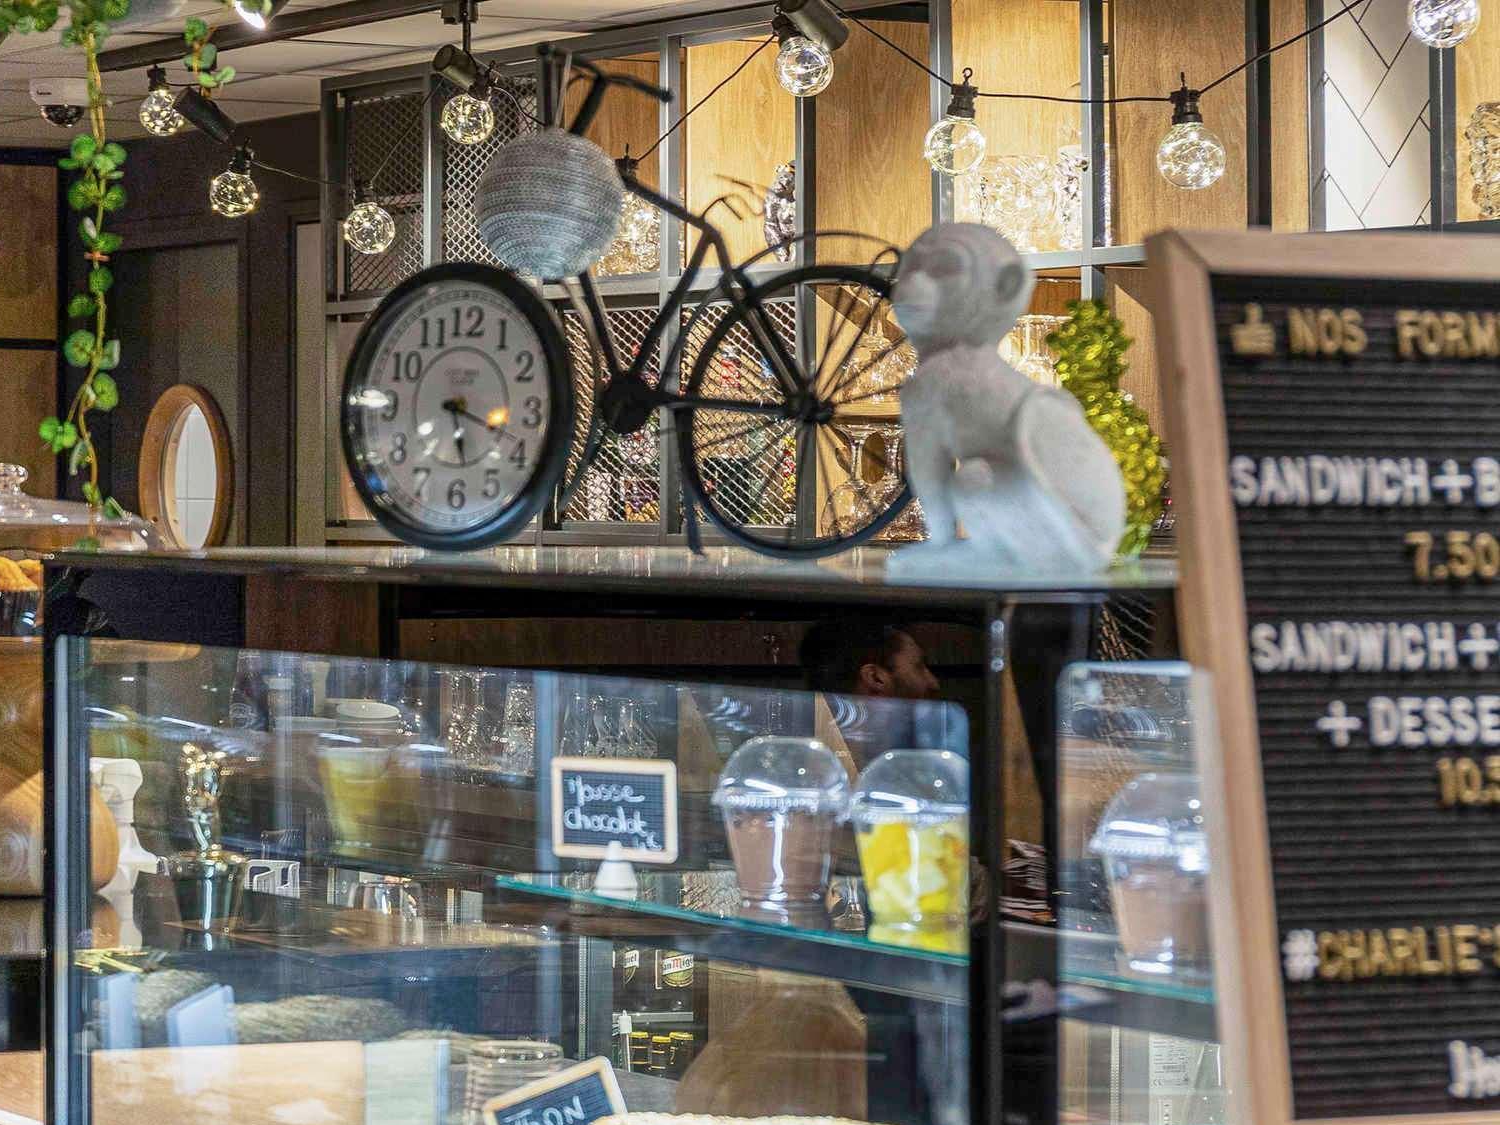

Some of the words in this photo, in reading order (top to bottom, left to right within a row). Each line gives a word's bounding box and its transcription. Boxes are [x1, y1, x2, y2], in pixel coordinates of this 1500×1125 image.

[419, 316, 446, 348] 11
[451, 305, 485, 338] 12
[497, 317, 508, 351] 1
[1287, 307, 1368, 355] NOS
[1395, 309, 1500, 358] FORM
[391, 350, 423, 382] 10
[514, 350, 536, 383] 2
[380, 389, 399, 422] 9
[522, 395, 542, 428] 3
[390, 431, 408, 465] 8
[508, 438, 527, 471] 4
[412, 466, 432, 497] 7
[447, 478, 467, 511] 6
[481, 468, 501, 498] 5
[1405, 530, 1500, 580] 7.50
[1251, 619, 1500, 672] SANDWICH+
[1368, 695, 1500, 747] DESSE
